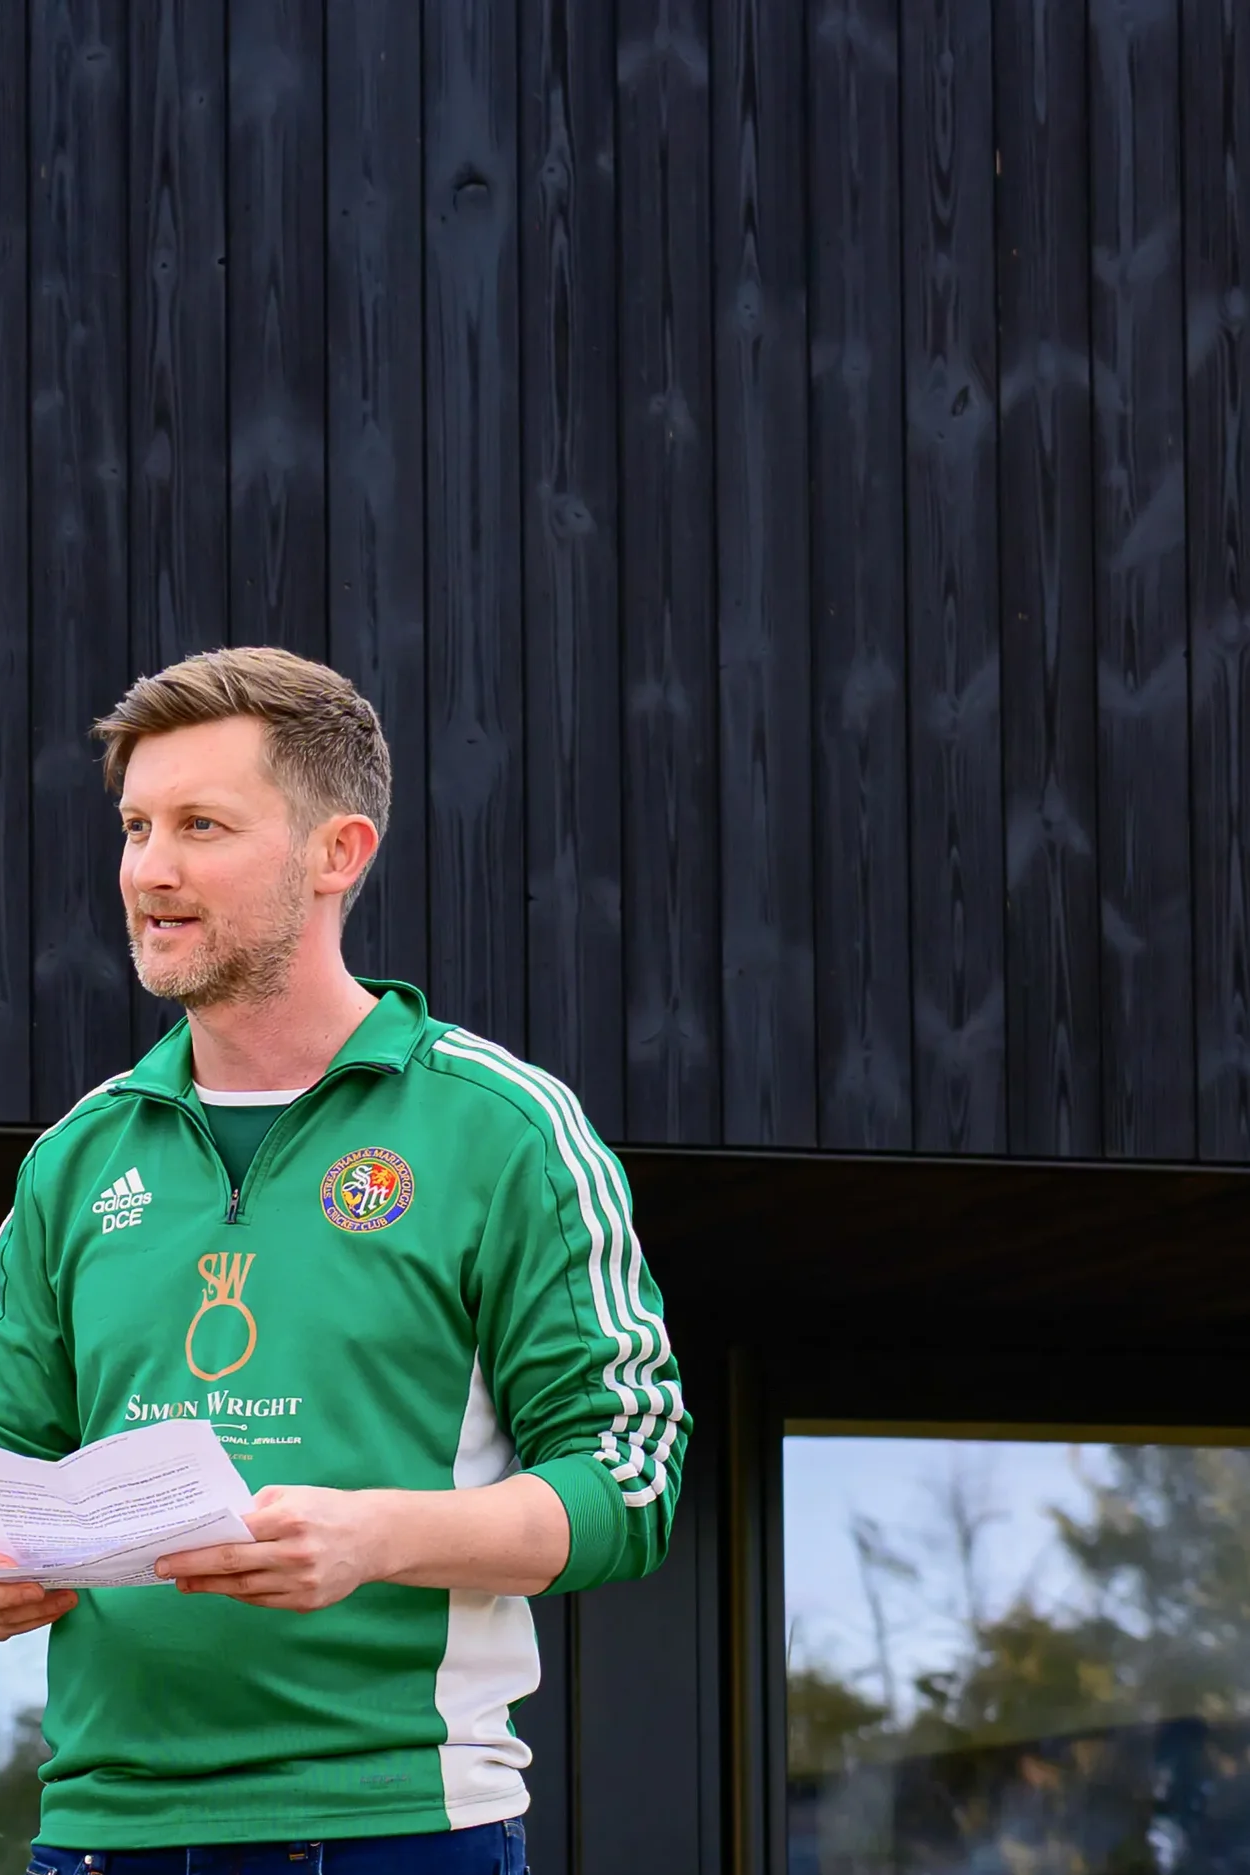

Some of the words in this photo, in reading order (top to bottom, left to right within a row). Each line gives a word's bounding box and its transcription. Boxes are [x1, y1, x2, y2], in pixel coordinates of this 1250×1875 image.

[323, 1151, 362, 1199] STREATHAM
[373, 1149, 412, 1209] MARLBOROUGH
[92, 1192, 152, 1213] adidas
[102, 1208, 144, 1235] DCE
[327, 1207, 360, 1230] CRICKET
[361, 1217, 388, 1230] CLUB
[197, 1251, 257, 1302] SW
[125, 1394, 199, 1421] SIMON
[207, 1390, 303, 1417] WRIGHT
[251, 1436, 302, 1445] JEWELLER
